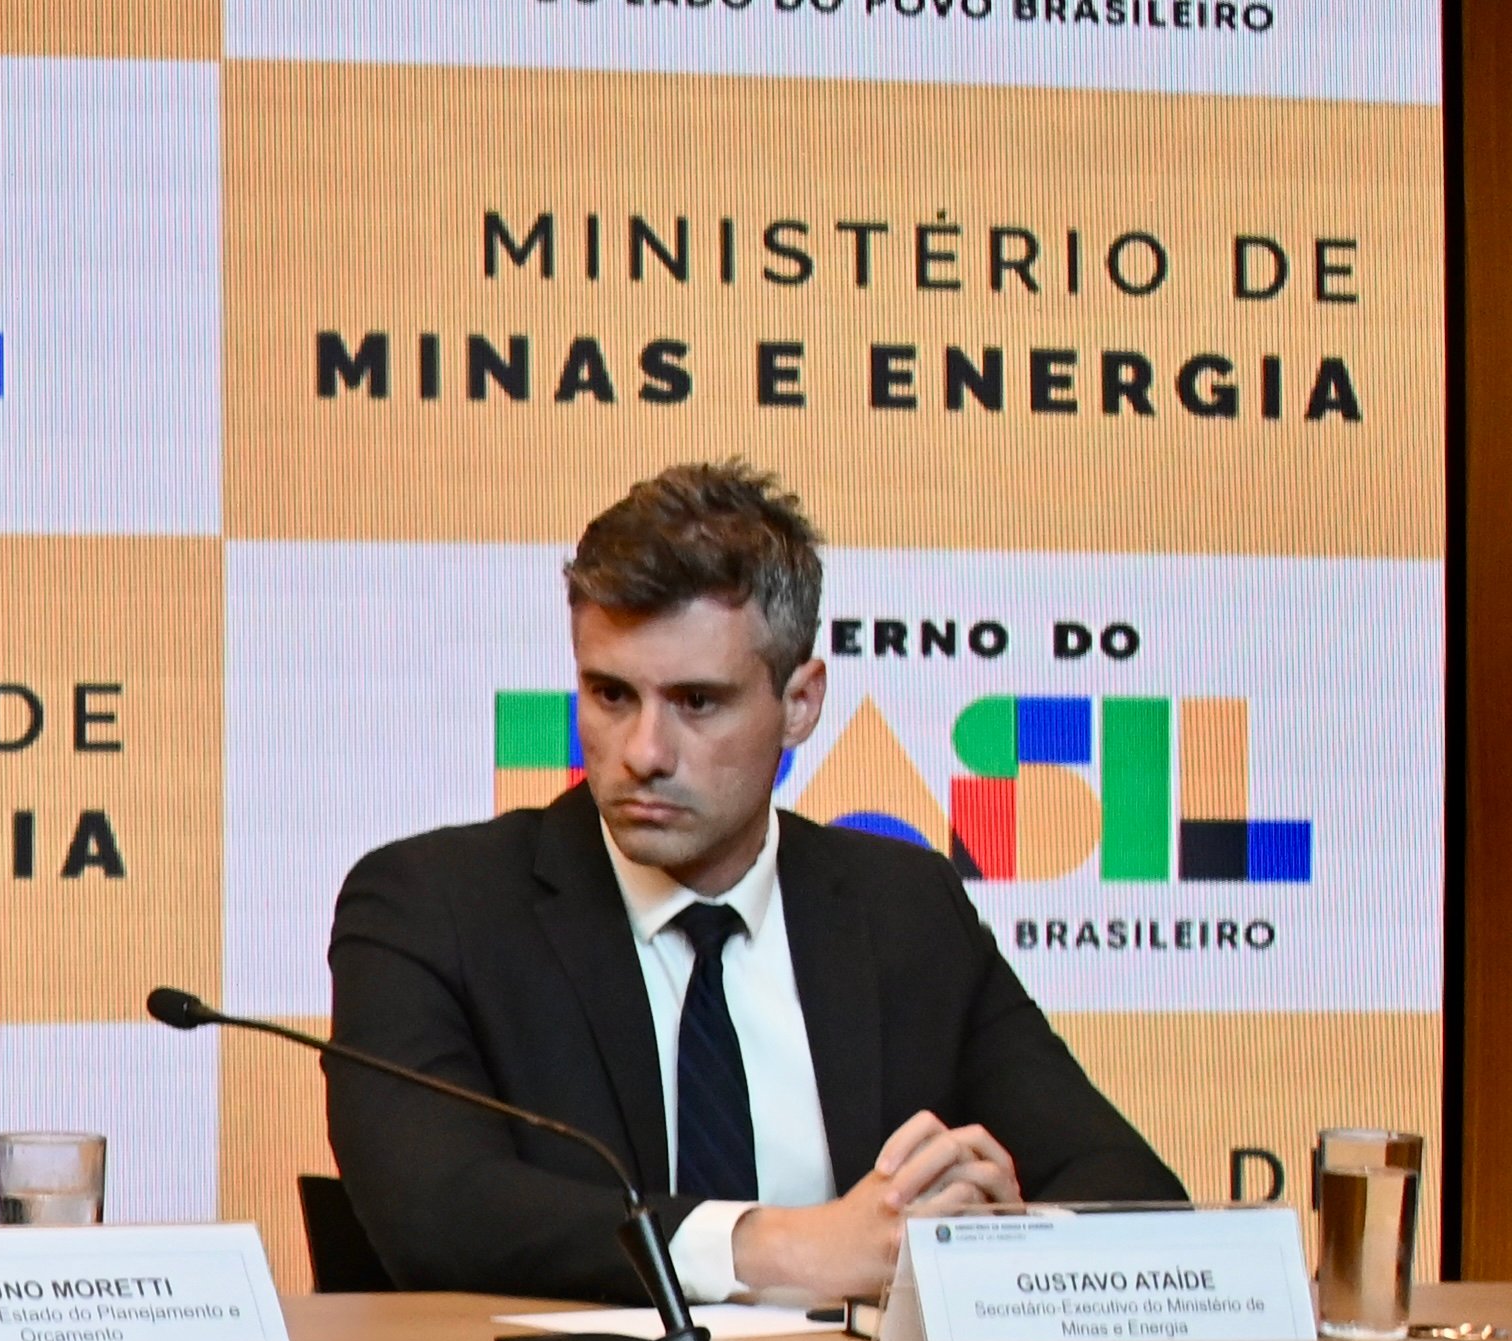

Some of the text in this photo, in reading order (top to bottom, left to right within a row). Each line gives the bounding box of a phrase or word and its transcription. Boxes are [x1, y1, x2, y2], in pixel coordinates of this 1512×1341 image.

[1012, 0, 1276, 34] BRASILEIRO
[483, 210, 1358, 304] MINISTÉRIO DE
[316, 331, 1362, 422] MINAS E ENERGIA
[832, 619, 1140, 661] ERNO DO
[1015, 919, 1276, 950] BRASILEIRO
[51, 1278, 173, 1299] MORETTI
[1016, 1266, 1216, 1293] GUSTAVO ATAÍDE
[68, 1305, 92, 1322] do
[96, 1303, 224, 1324] Planejamento
[228, 1306, 241, 1318] e
[974, 1297, 1265, 1317] Secretário-Executivo do Ministério de
[1061, 1319, 1189, 1339] Minas e Energia
